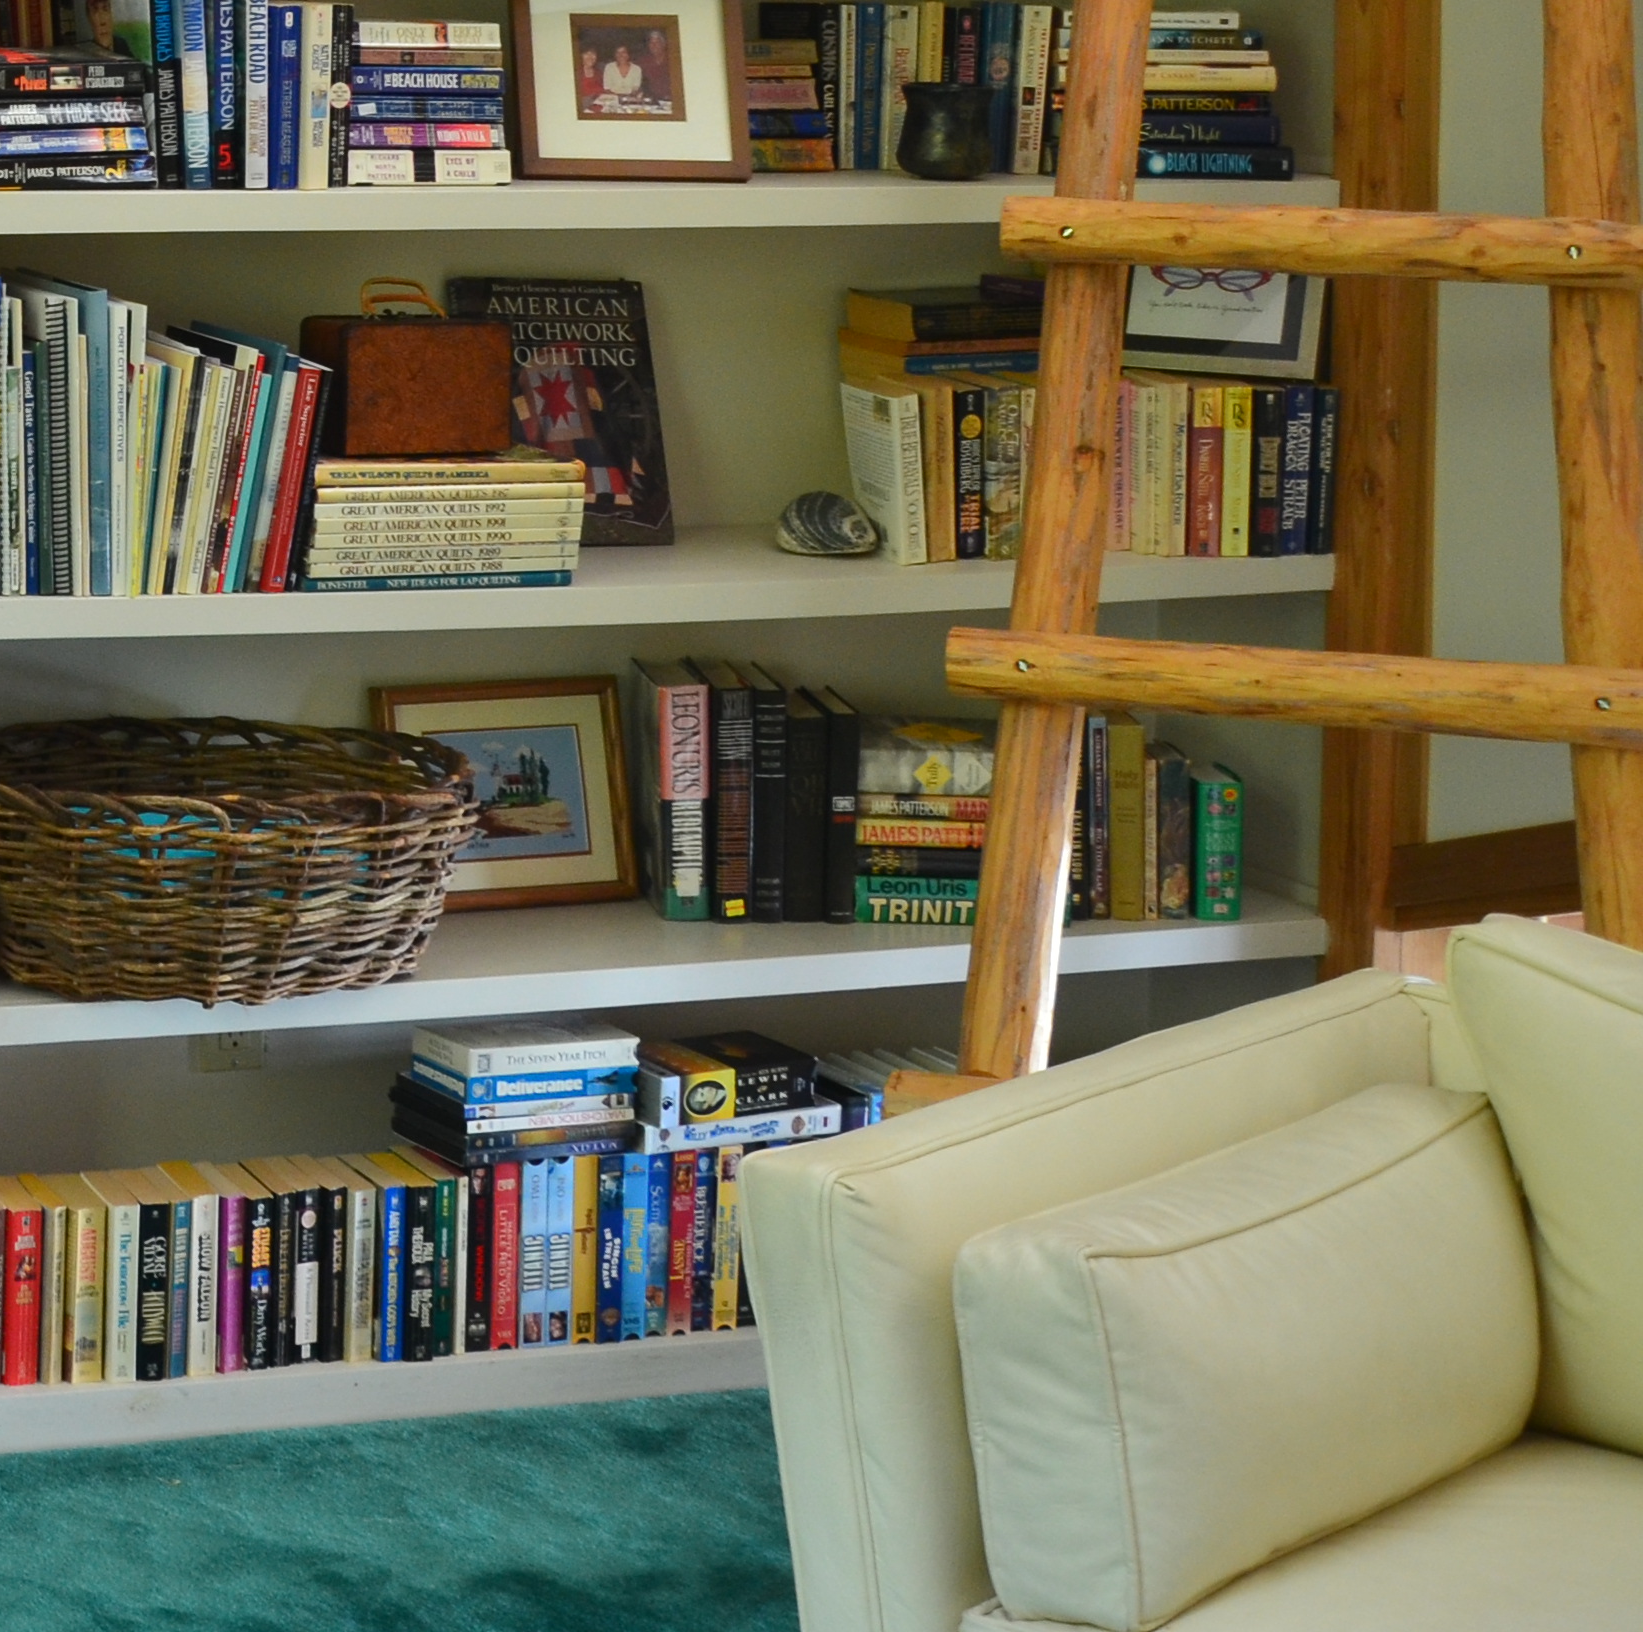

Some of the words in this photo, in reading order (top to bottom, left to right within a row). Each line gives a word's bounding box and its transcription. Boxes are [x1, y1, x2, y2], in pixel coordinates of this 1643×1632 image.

[250, 43, 267, 83] ROAD
[488, 296, 628, 317] AMERICAN
[116, 326, 125, 350] PORT
[512, 322, 635, 342] TCHWORK
[116, 353, 125, 378] CITY
[514, 348, 636, 367] QUILTING
[116, 381, 125, 462] PERSPECTIVES
[341, 506, 381, 516] GREAT
[384, 505, 439, 515] AMERICAN
[443, 504, 481, 514] QUILTS
[486, 503, 506, 513] 1992
[507, 1055, 525, 1065] THE
[527, 1054, 557, 1064] SEVEN
[558, 1052, 581, 1062] YEAR
[583, 1050, 606, 1060] ITCH
[496, 1078, 583, 1097] Deliverance
